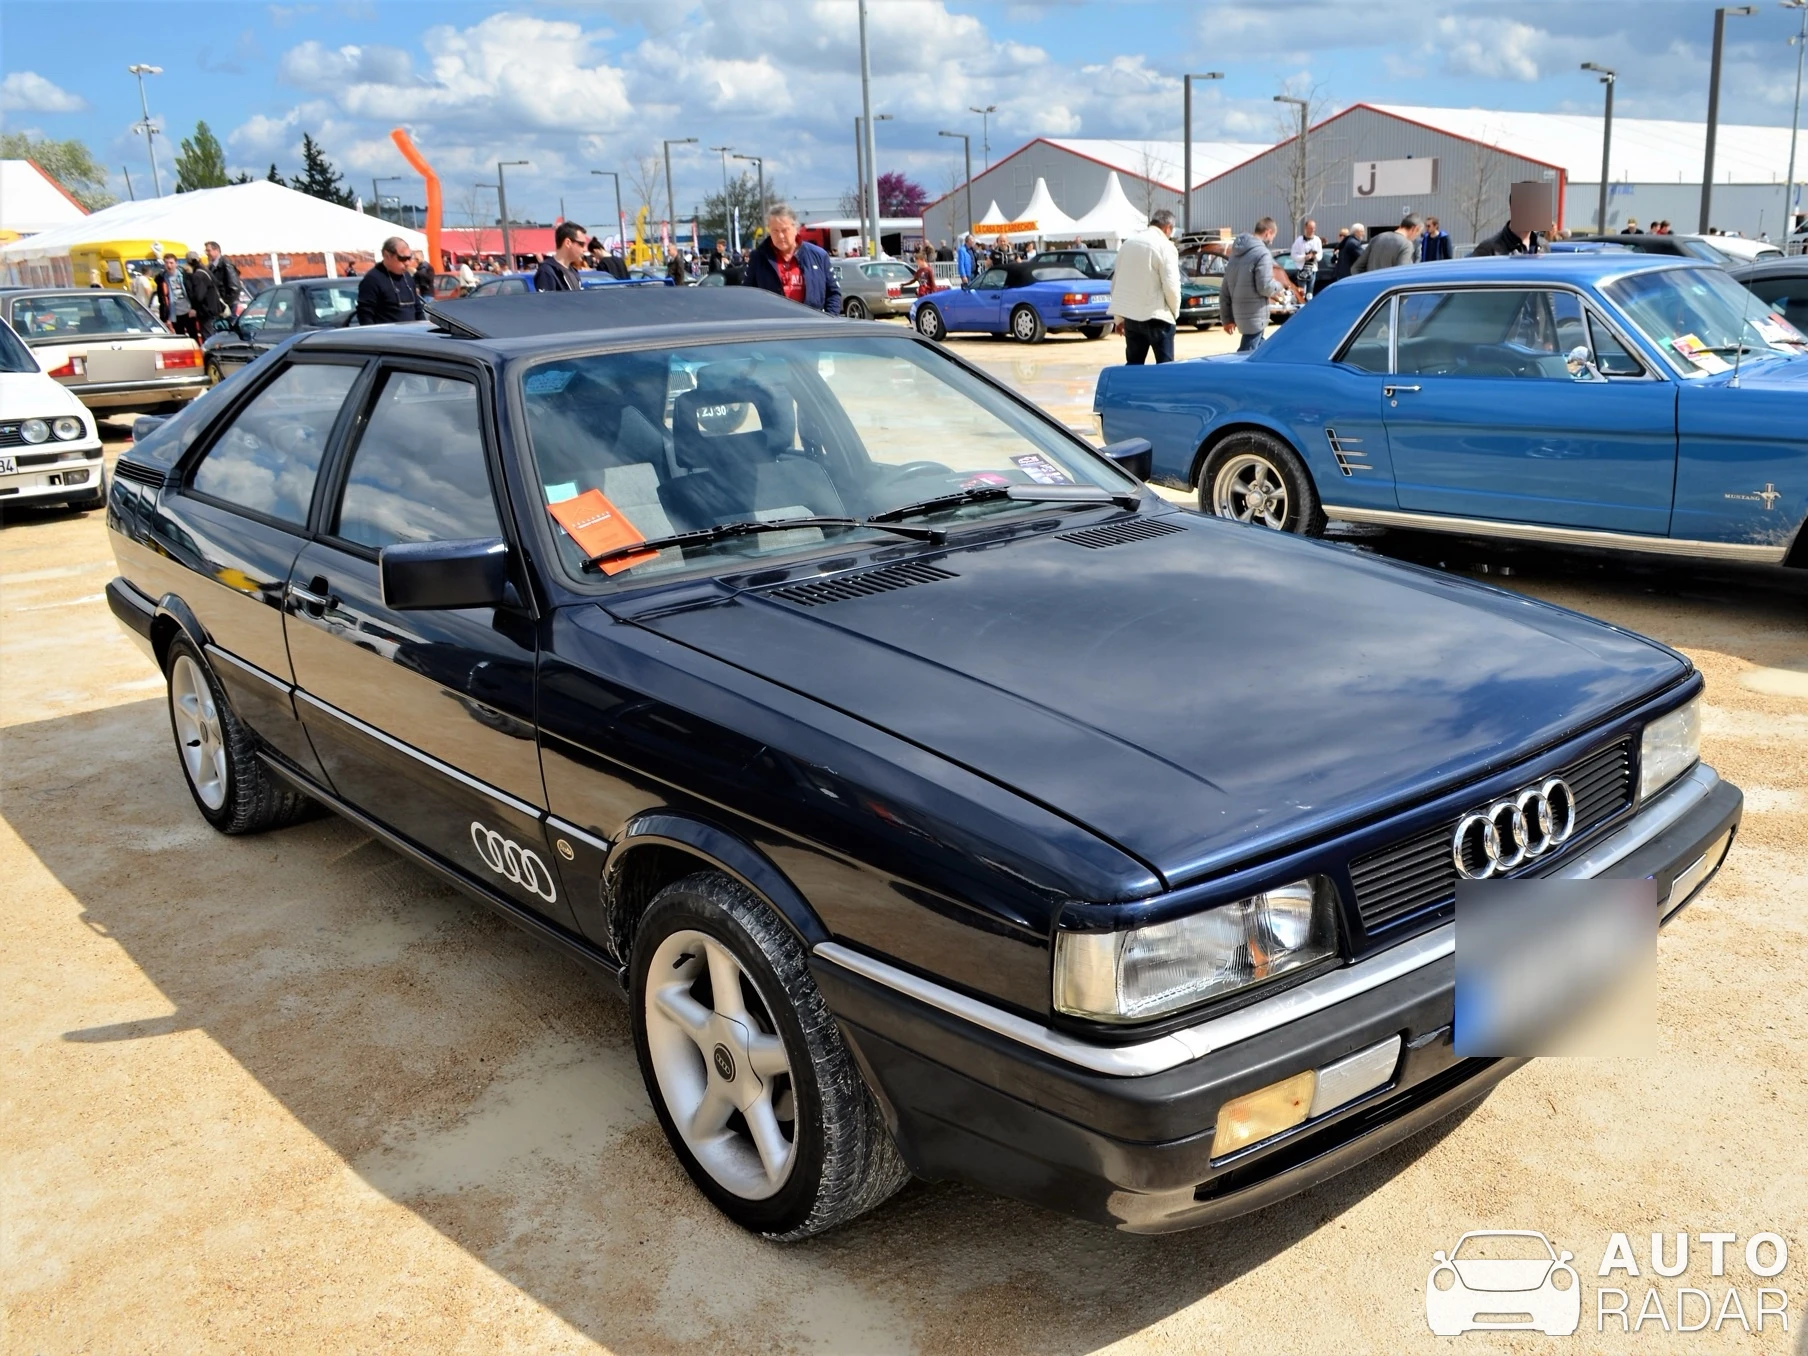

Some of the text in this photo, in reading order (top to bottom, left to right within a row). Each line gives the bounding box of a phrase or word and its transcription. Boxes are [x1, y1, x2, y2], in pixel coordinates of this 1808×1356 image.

[1357, 164, 1376, 196] j
[715, 405, 727, 416] 30
[1724, 493, 1760, 501] MUSTANG
